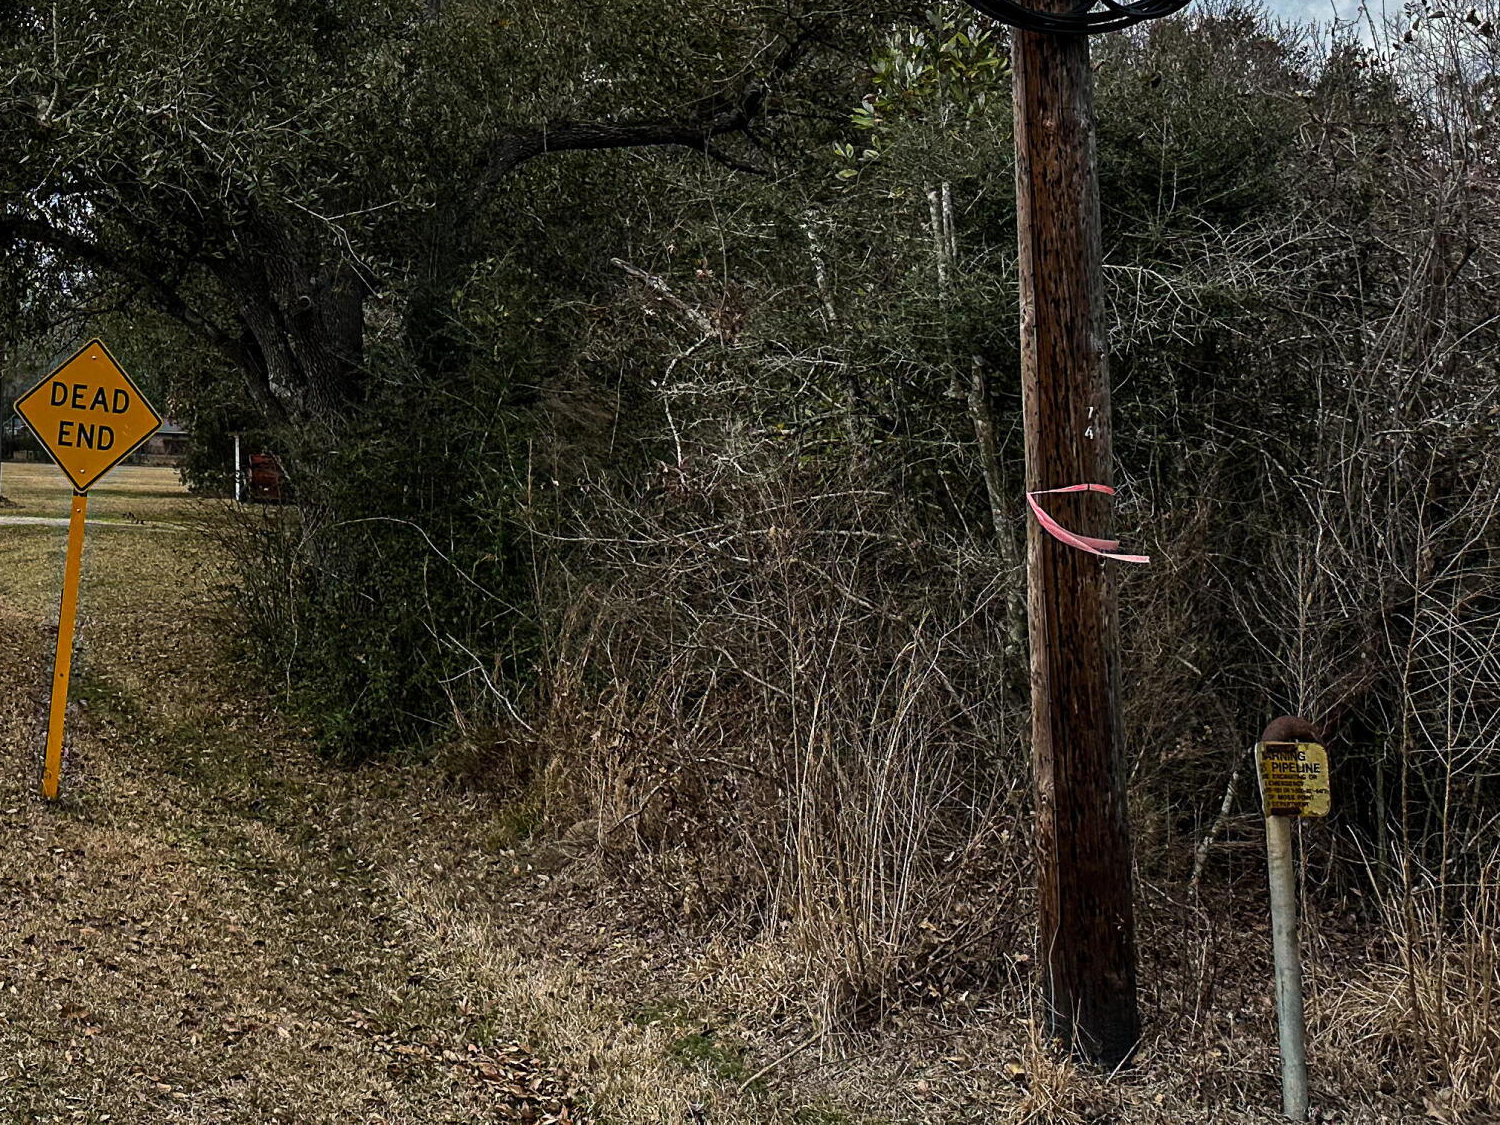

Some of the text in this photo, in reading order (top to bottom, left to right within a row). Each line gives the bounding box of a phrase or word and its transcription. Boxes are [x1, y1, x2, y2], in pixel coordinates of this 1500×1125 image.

[50, 381, 130, 414] DEAD
[58, 420, 115, 451] END
[1271, 762, 1321, 774] PIPELINE
